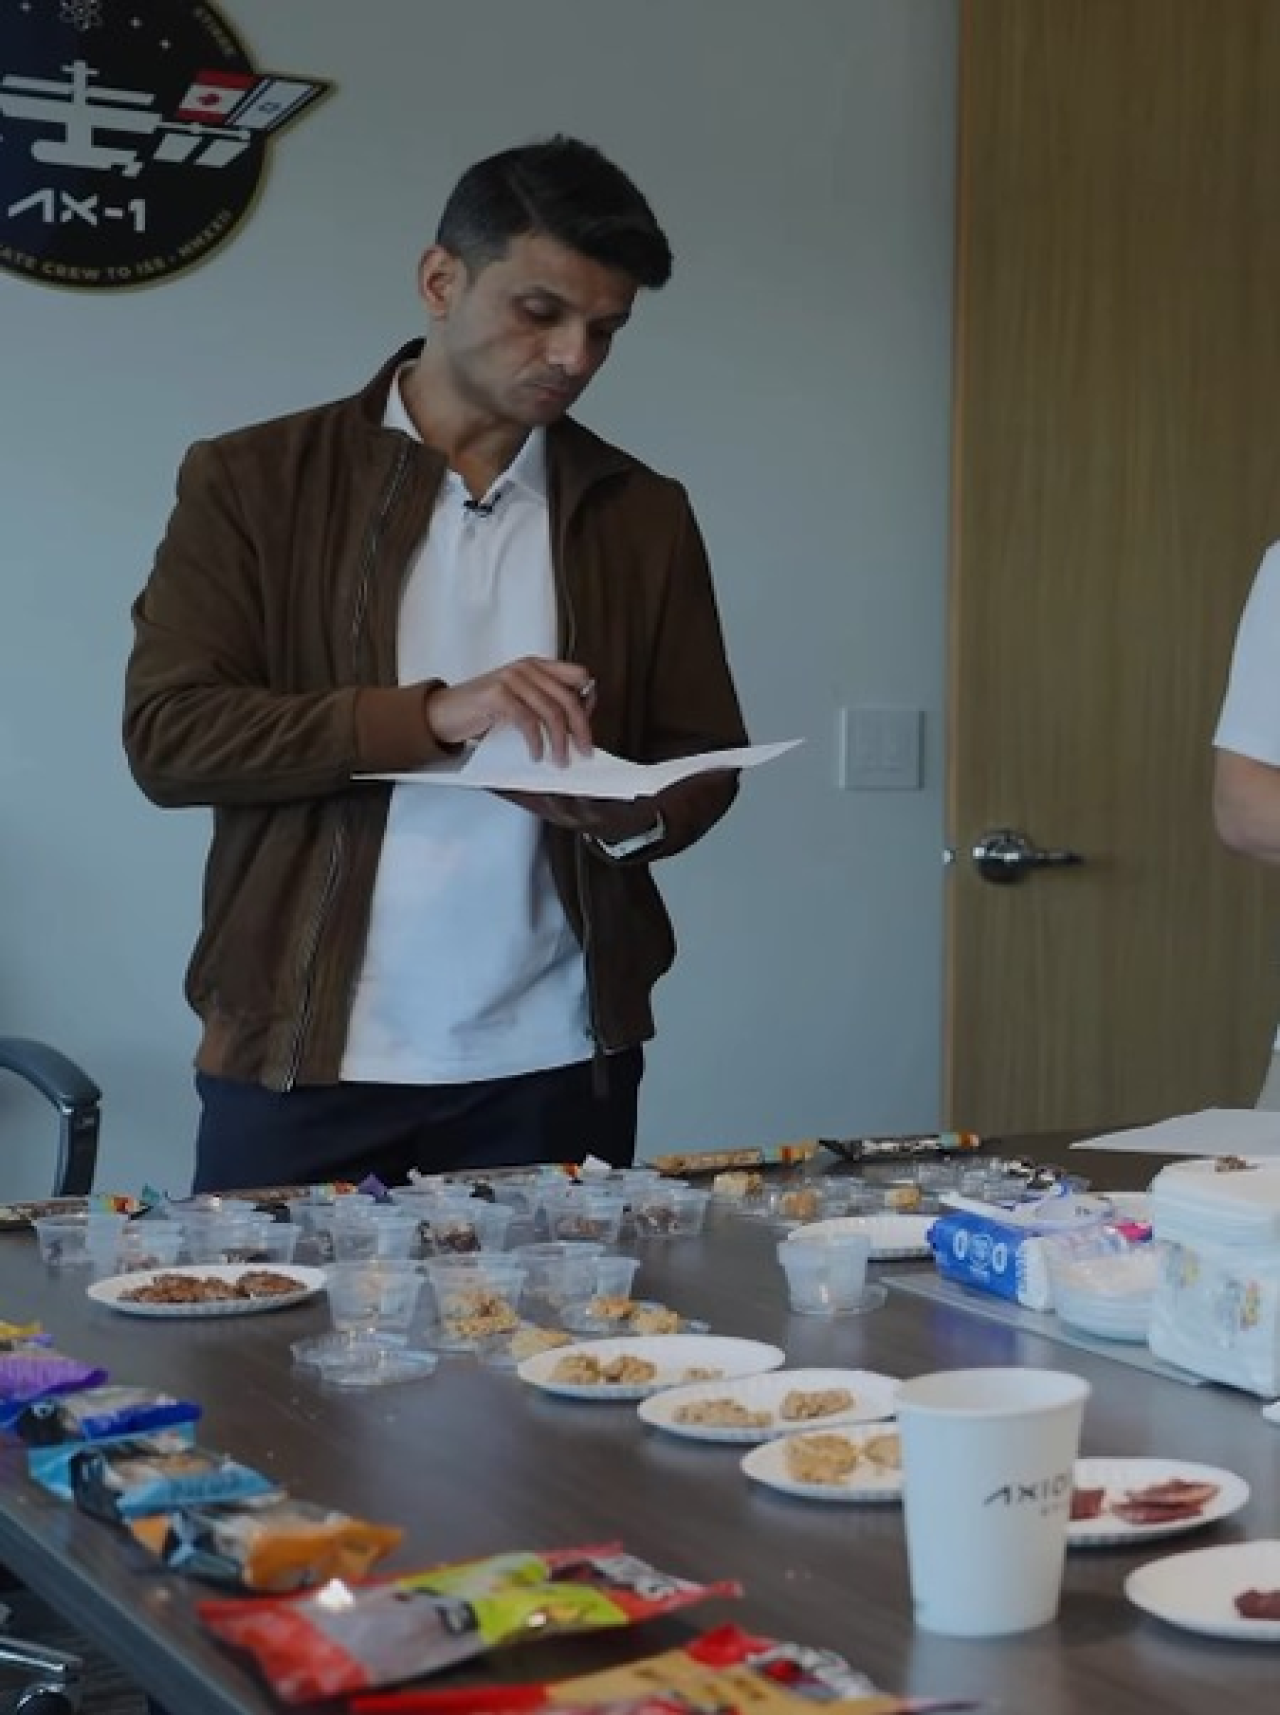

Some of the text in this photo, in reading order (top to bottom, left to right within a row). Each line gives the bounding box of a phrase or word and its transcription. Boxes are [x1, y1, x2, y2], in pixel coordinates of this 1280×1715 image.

[0, 243, 38, 271] ATE
[41, 261, 101, 282] CREW
[107, 265, 132, 281] TO
[981, 1471, 1069, 1506] AXIO
